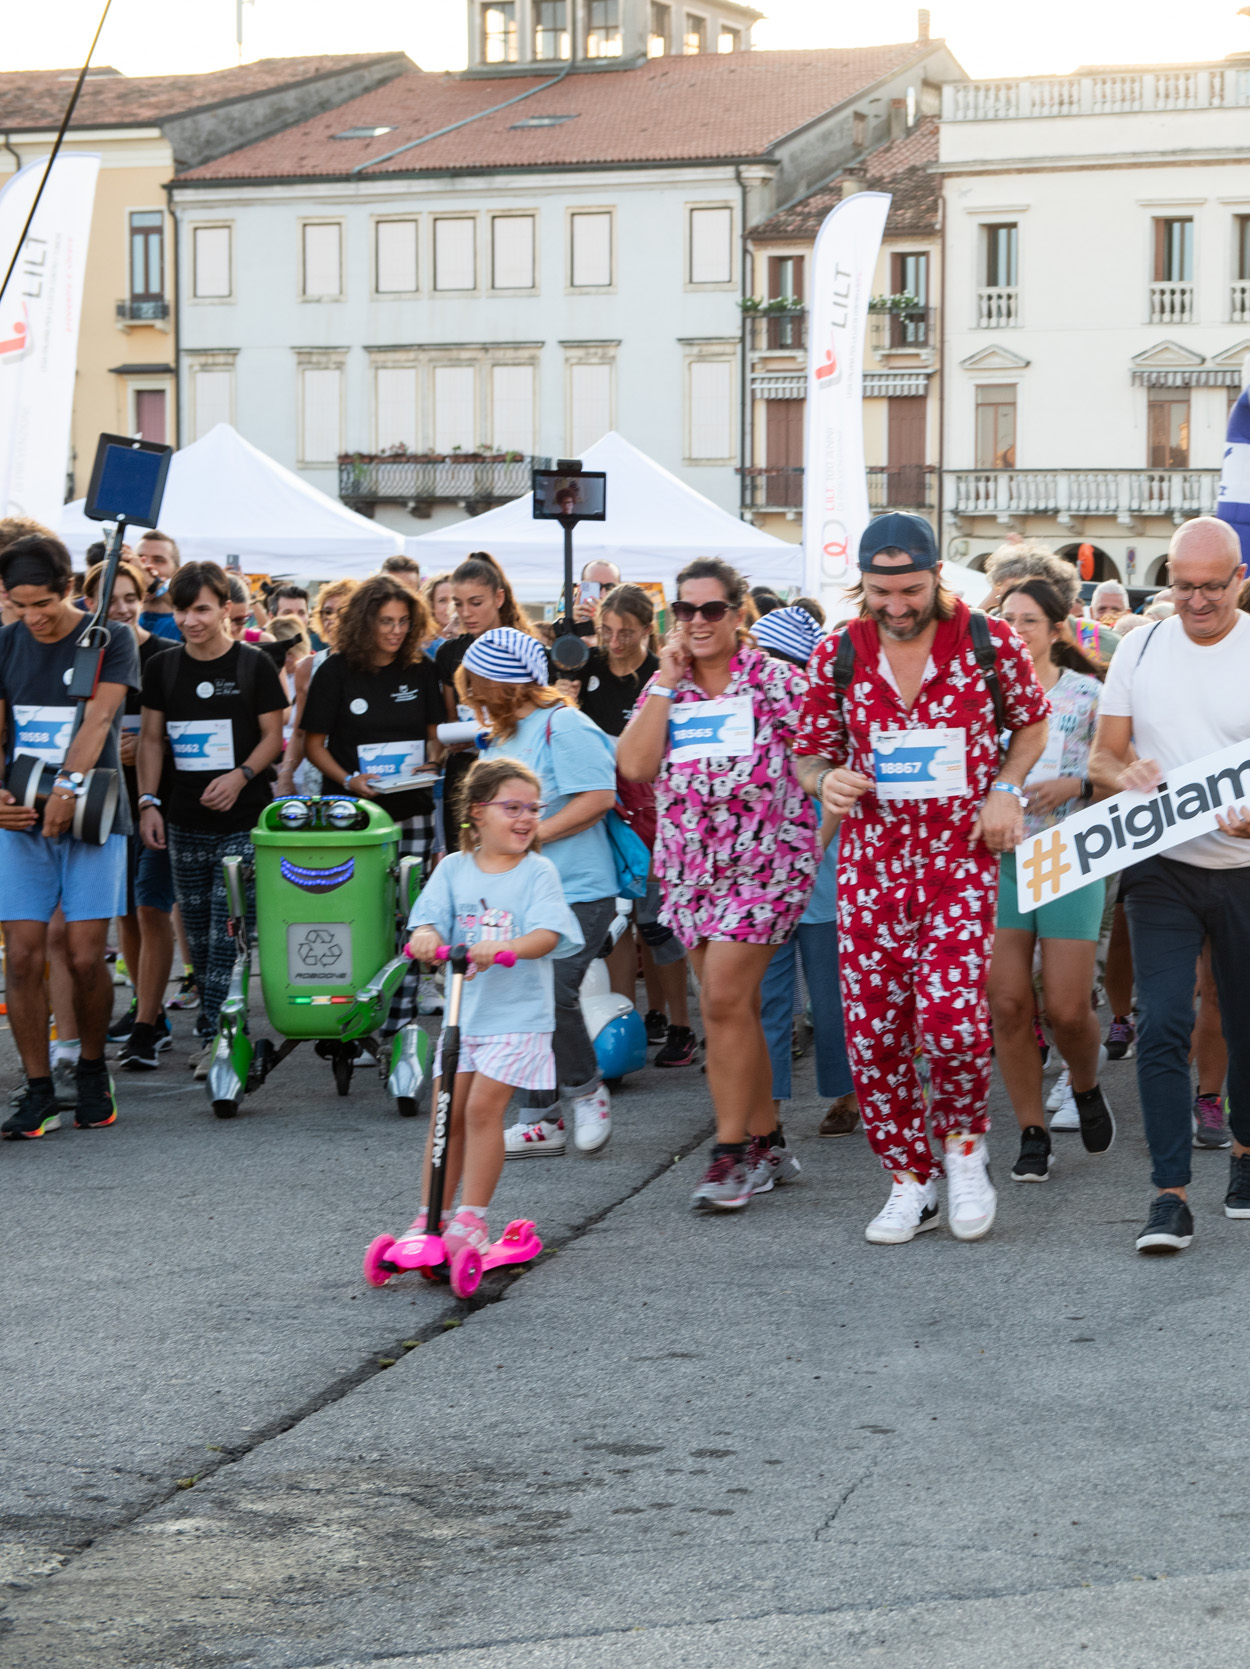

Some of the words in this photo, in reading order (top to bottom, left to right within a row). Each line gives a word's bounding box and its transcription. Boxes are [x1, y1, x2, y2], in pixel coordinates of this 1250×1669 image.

[22, 235, 48, 299] LILT
[830, 261, 852, 329] LILT
[672, 728, 715, 741] 18565
[879, 761, 923, 775] 18867
